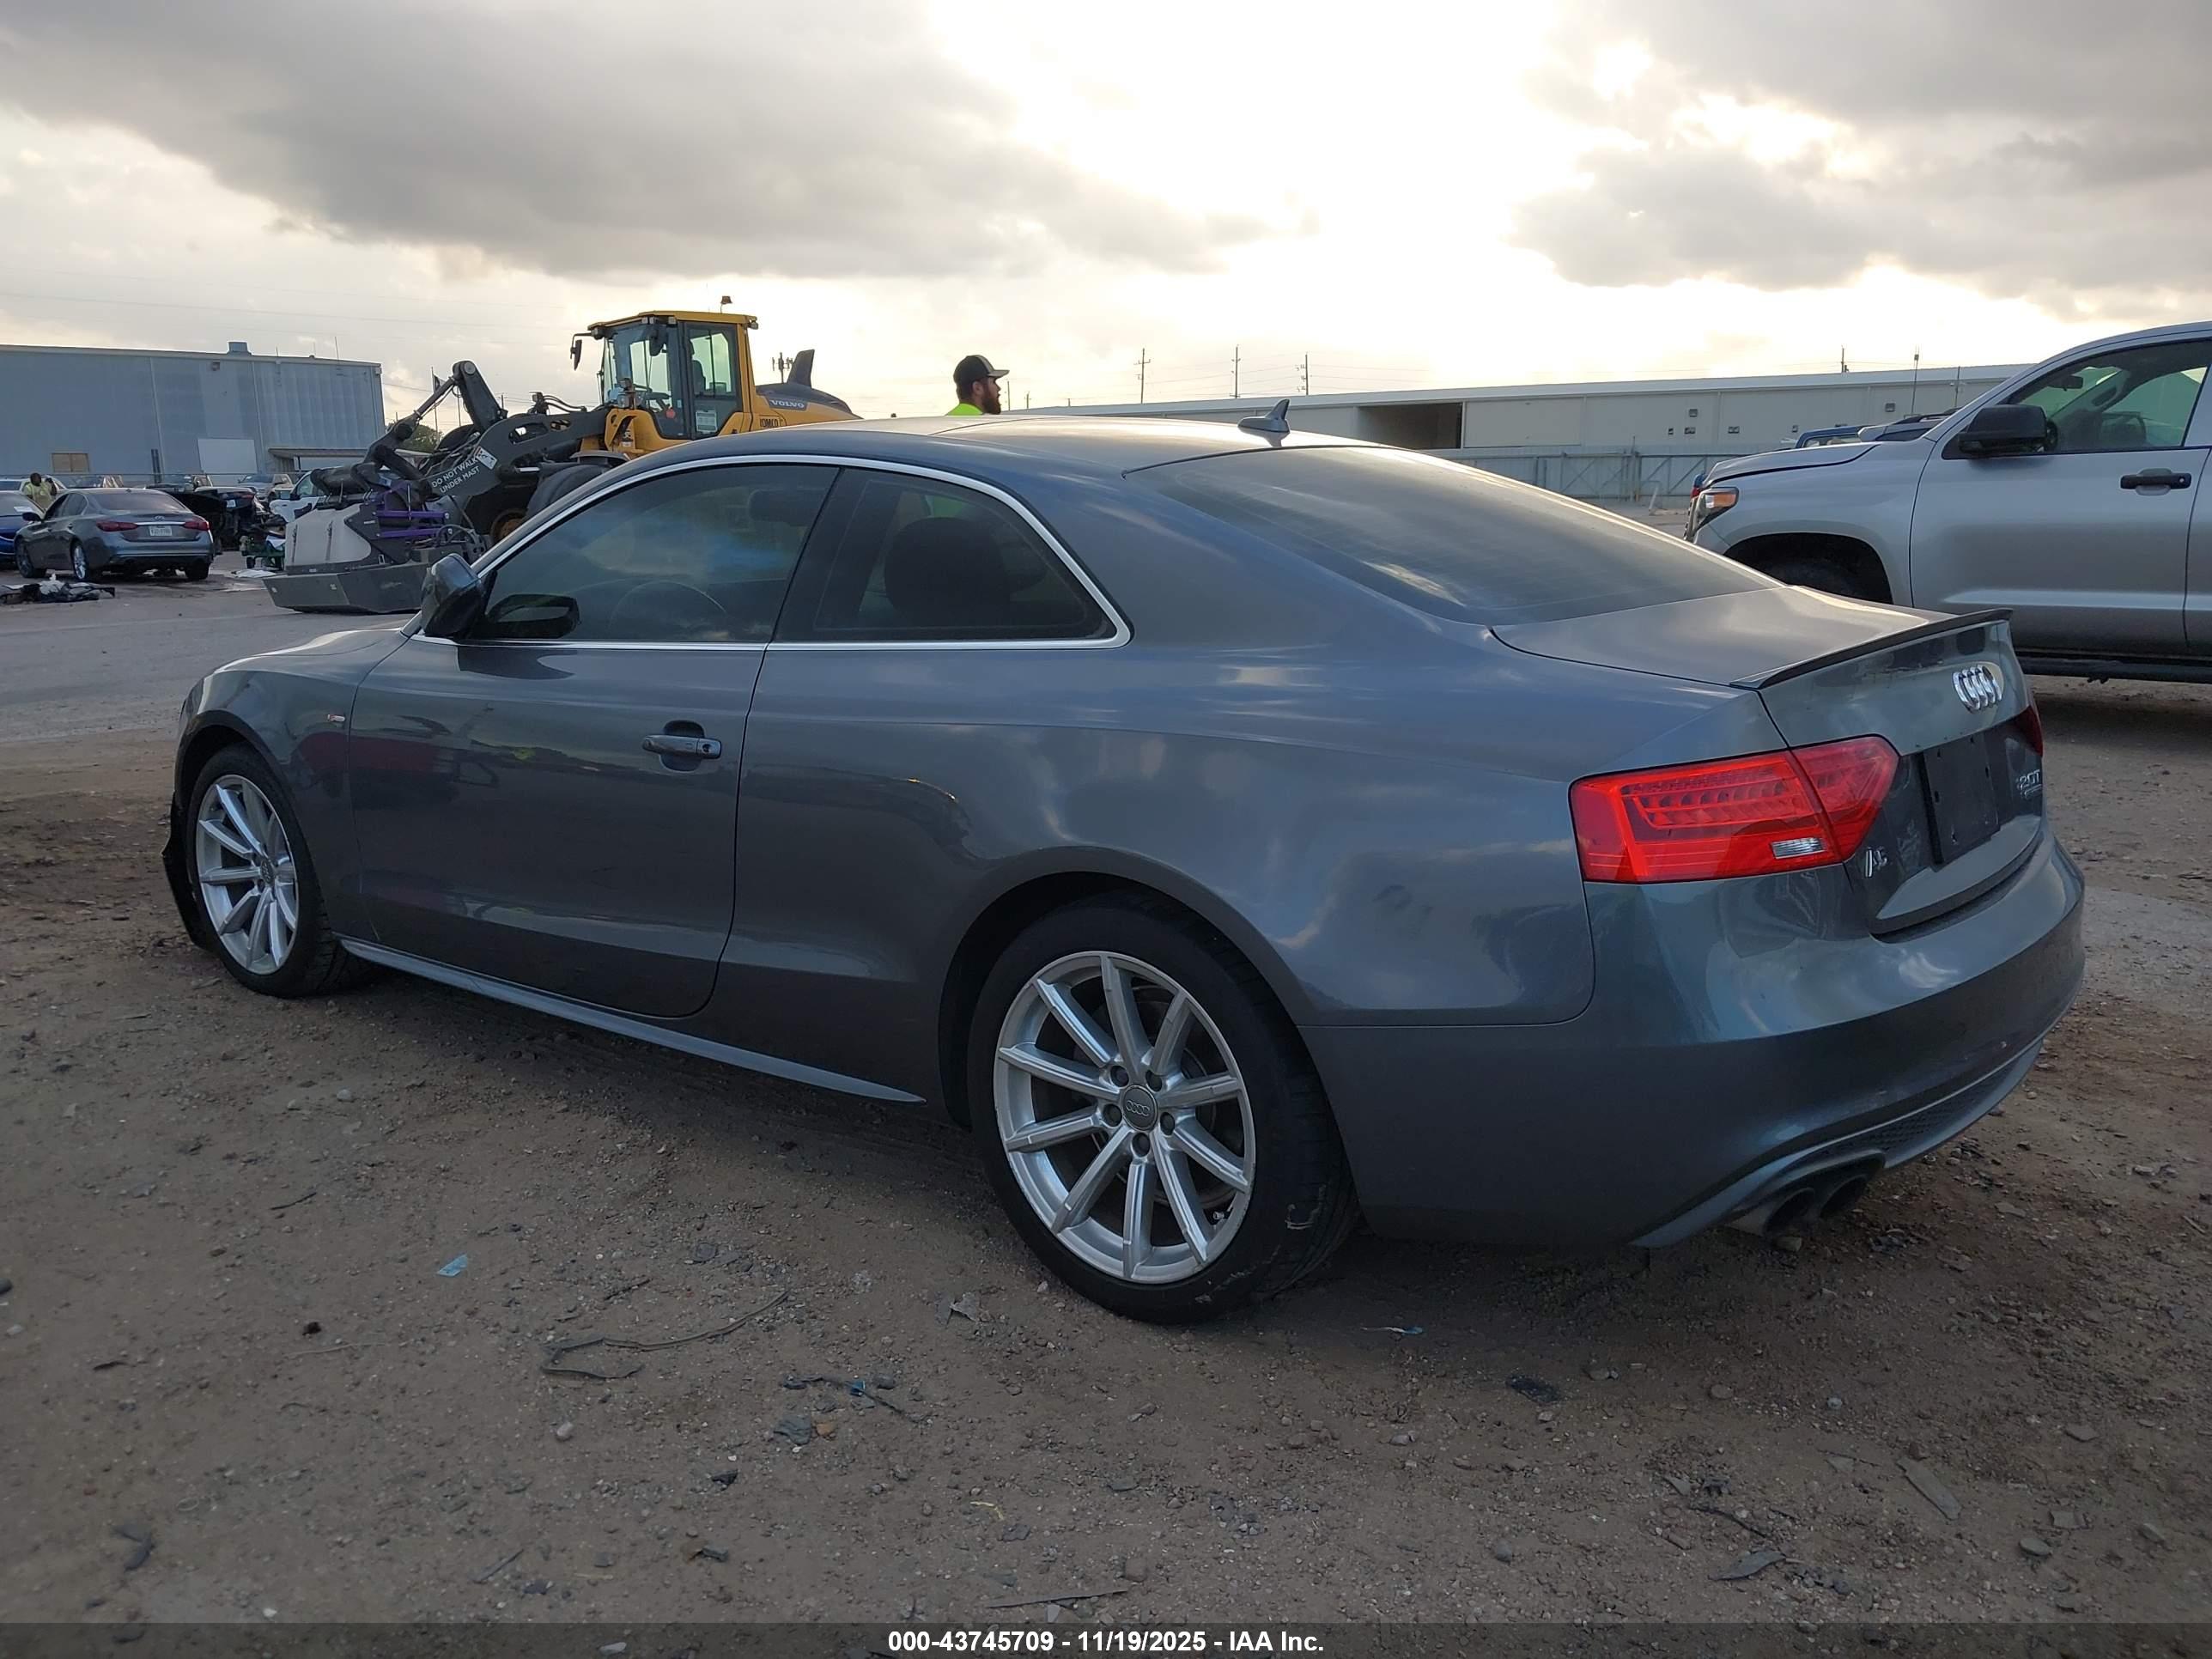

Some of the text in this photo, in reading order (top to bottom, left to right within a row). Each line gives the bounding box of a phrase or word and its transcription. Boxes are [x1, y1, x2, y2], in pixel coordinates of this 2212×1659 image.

[769, 399, 805, 408] VOLVO
[431, 458, 478, 488] DO NOT WALK
[440, 465, 480, 493] UNDER MAST
